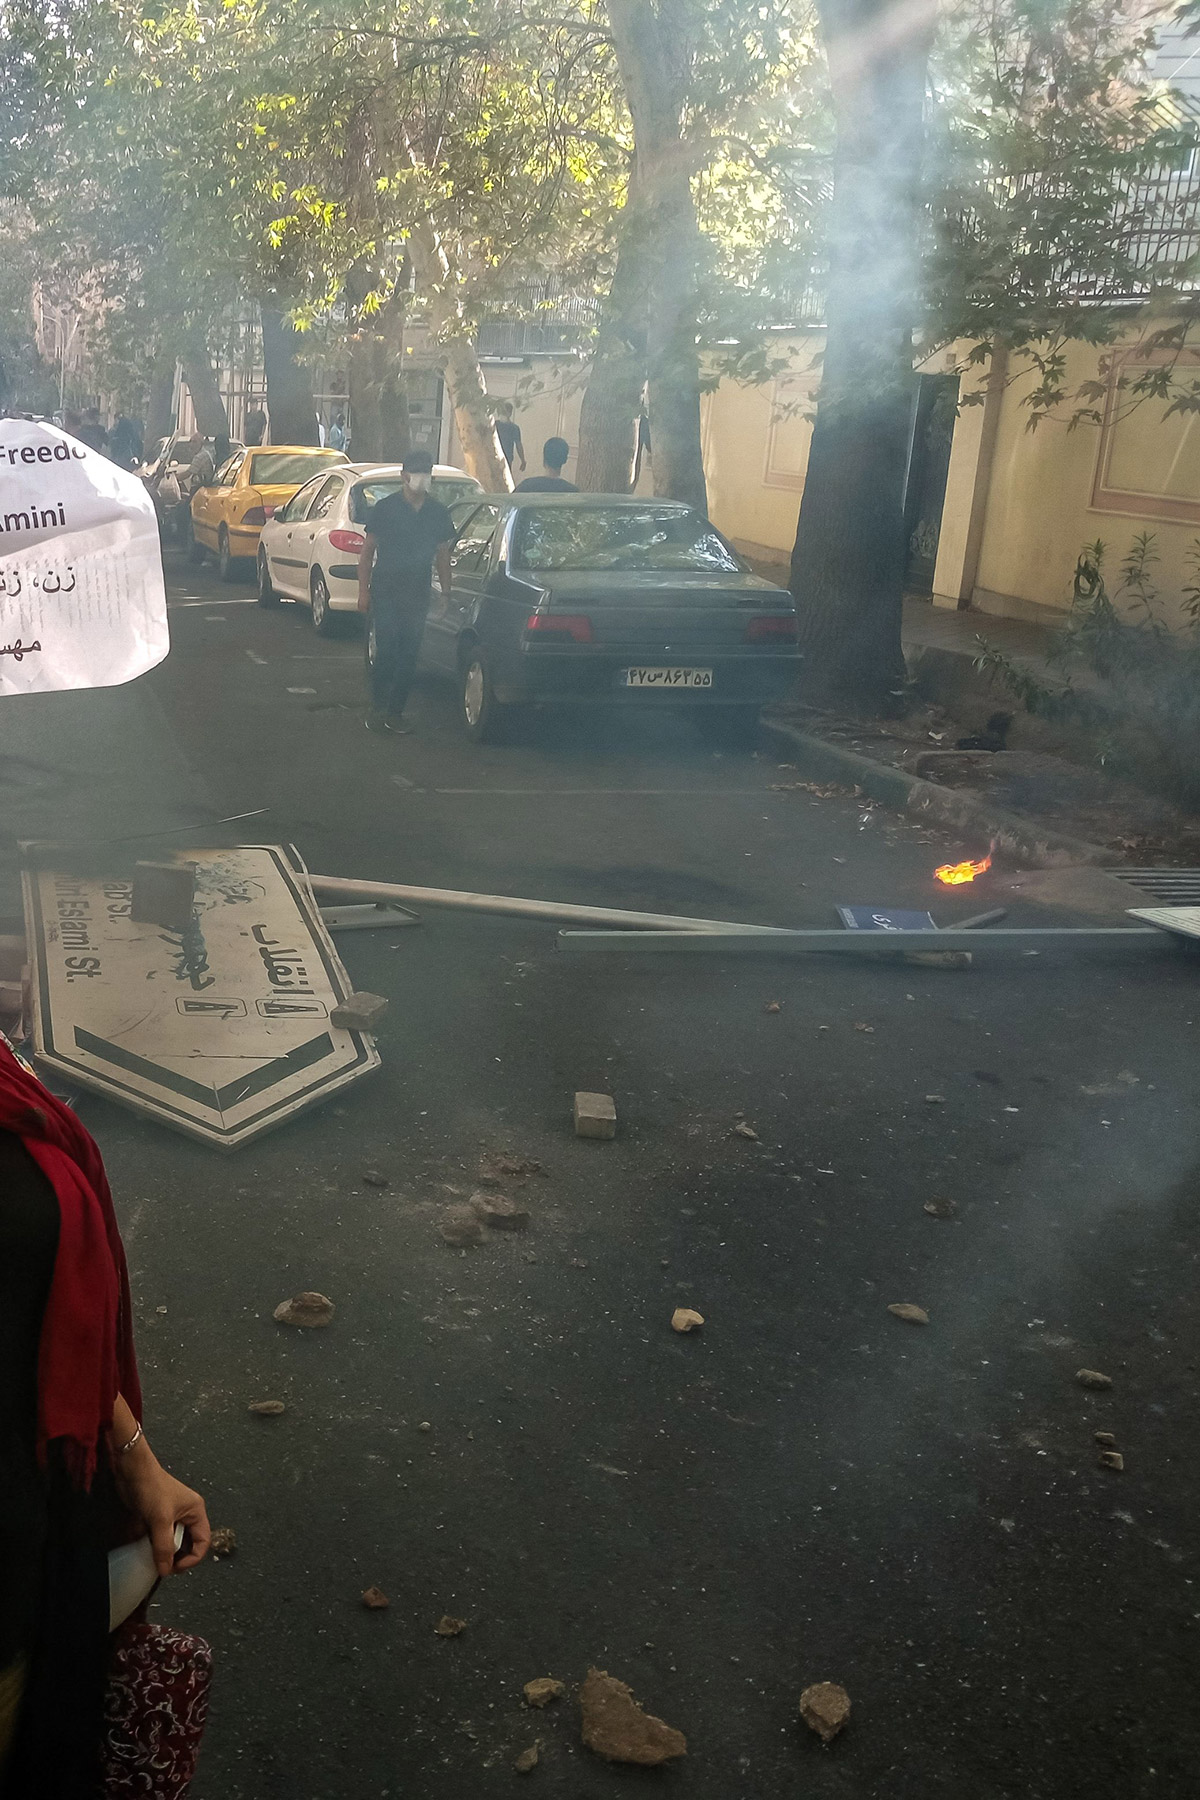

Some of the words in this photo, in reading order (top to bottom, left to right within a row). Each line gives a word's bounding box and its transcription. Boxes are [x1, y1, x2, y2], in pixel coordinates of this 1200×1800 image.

[56, 899, 99, 951] Eslami
[64, 956, 103, 984] St.
[240, 923, 315, 995] انقلاب
